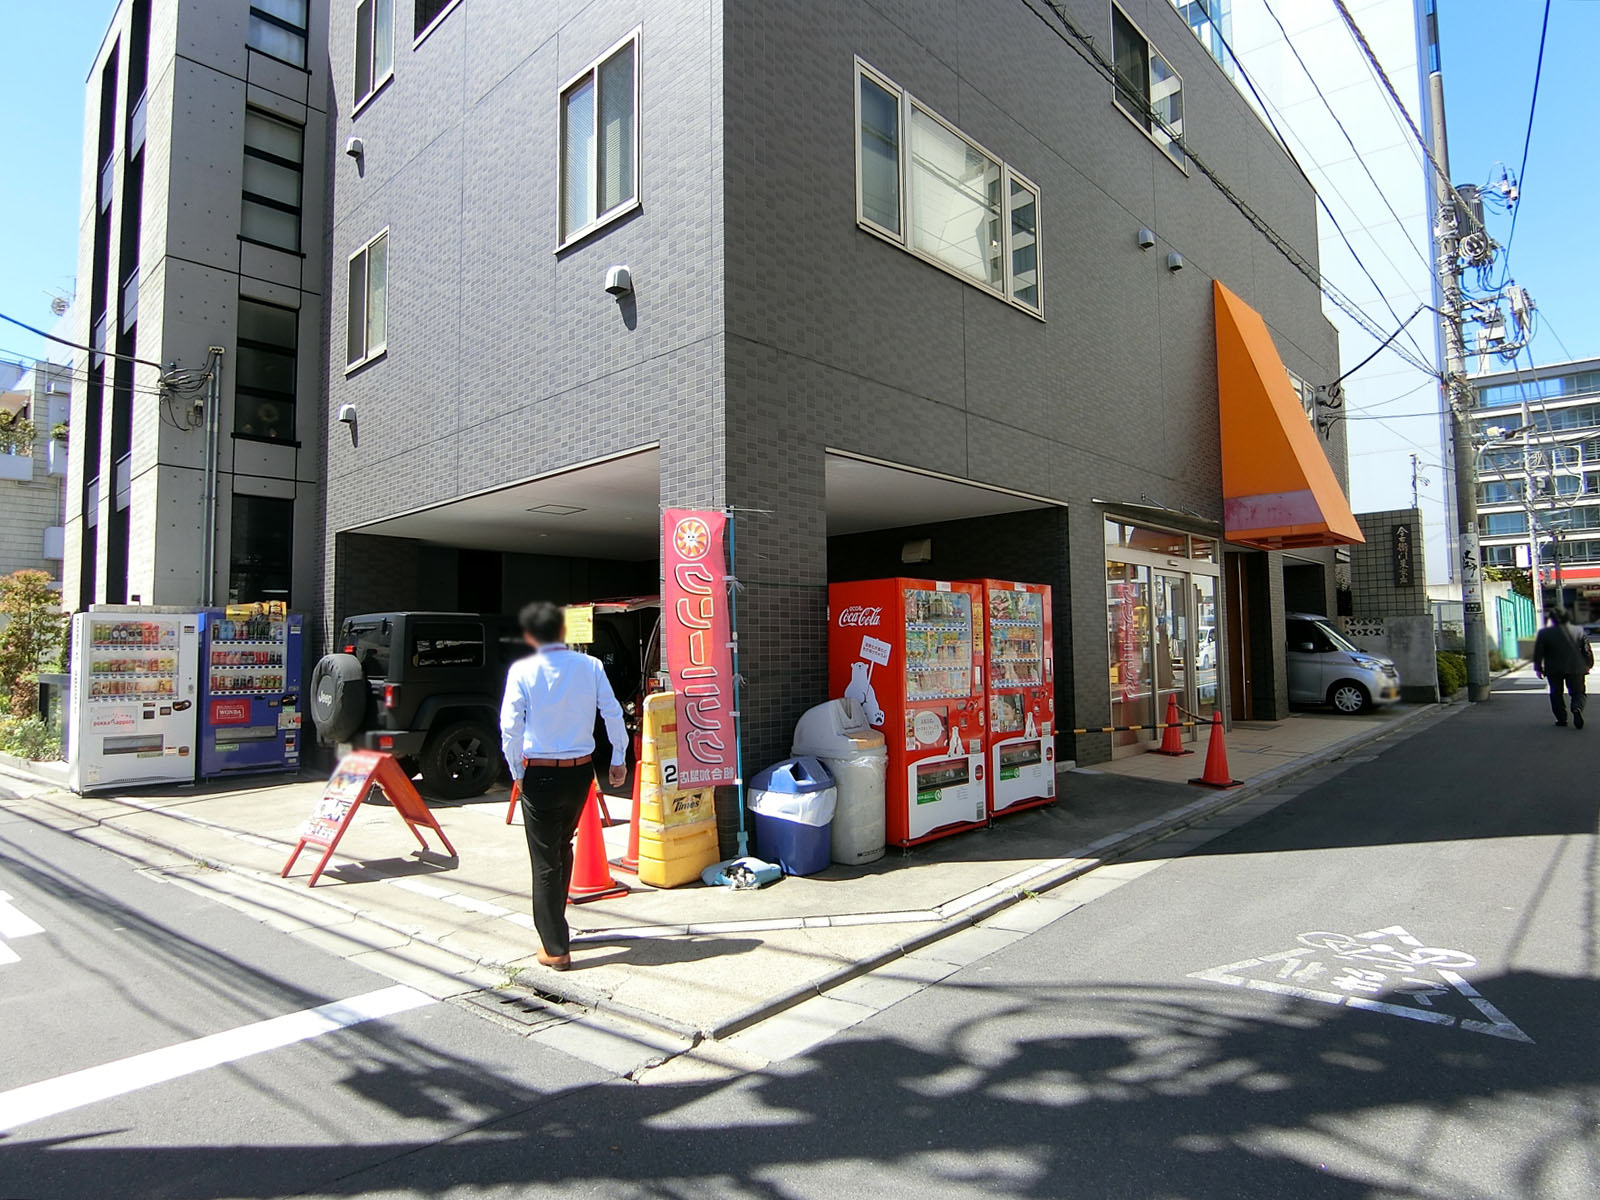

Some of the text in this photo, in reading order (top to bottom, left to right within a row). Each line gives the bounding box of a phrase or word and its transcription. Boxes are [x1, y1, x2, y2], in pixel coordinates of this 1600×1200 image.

[838, 606, 883, 627] Coca-Cola
[319, 690, 332, 707] Jeep
[673, 793, 702, 812] Times
